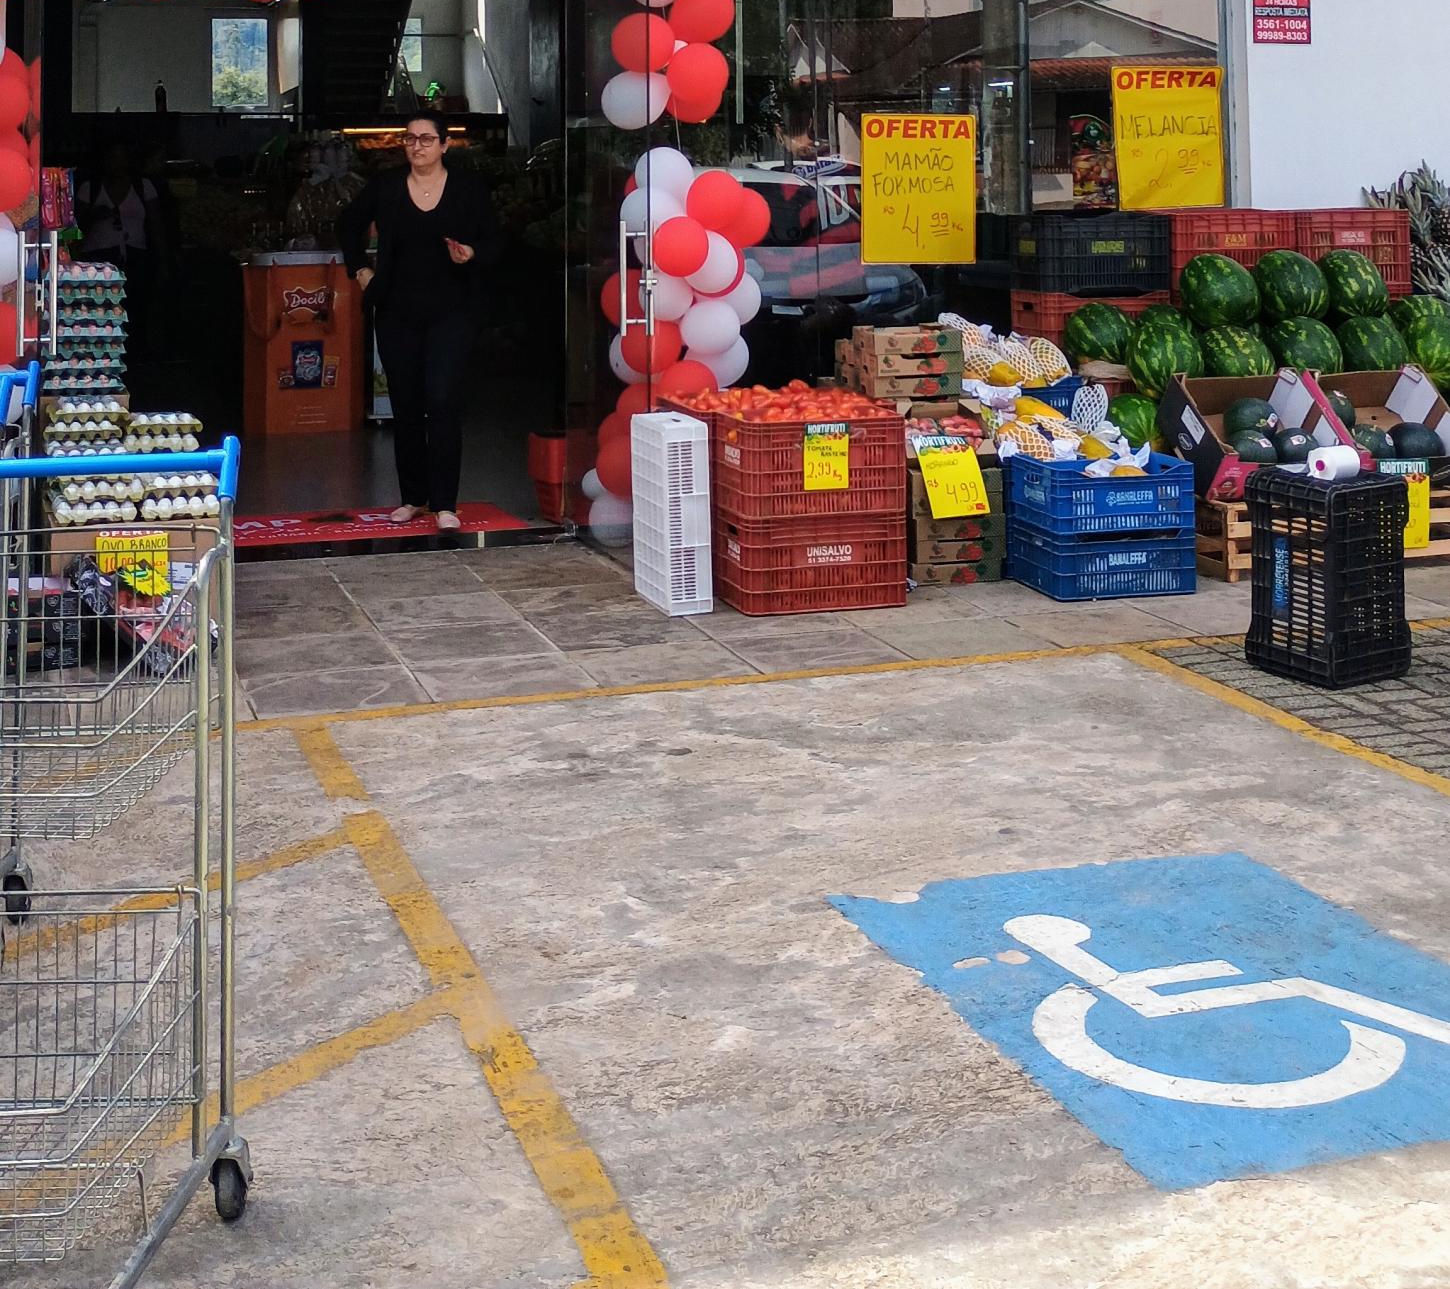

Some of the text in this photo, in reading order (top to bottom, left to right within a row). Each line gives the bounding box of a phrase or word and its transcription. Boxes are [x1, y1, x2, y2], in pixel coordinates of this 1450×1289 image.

[1256, 19, 1307, 29] 3561-1004
[1256, 31, 1308, 40] 99989-8303
[1116, 70, 1217, 90] OFERTA
[865, 118, 971, 139] OFERTA
[1119, 114, 1218, 141] MELANCIA
[884, 147, 954, 172] MAMÃO
[872, 172, 955, 197] FORMOSA
[807, 423, 846, 434] HORTIFRUTI
[912, 434, 966, 447] HORTIFRUTI
[1380, 461, 1426, 473] HORTIFRUTI
[130, 537, 167, 551] BRANCO
[806, 544, 853, 557] UNISALVO
